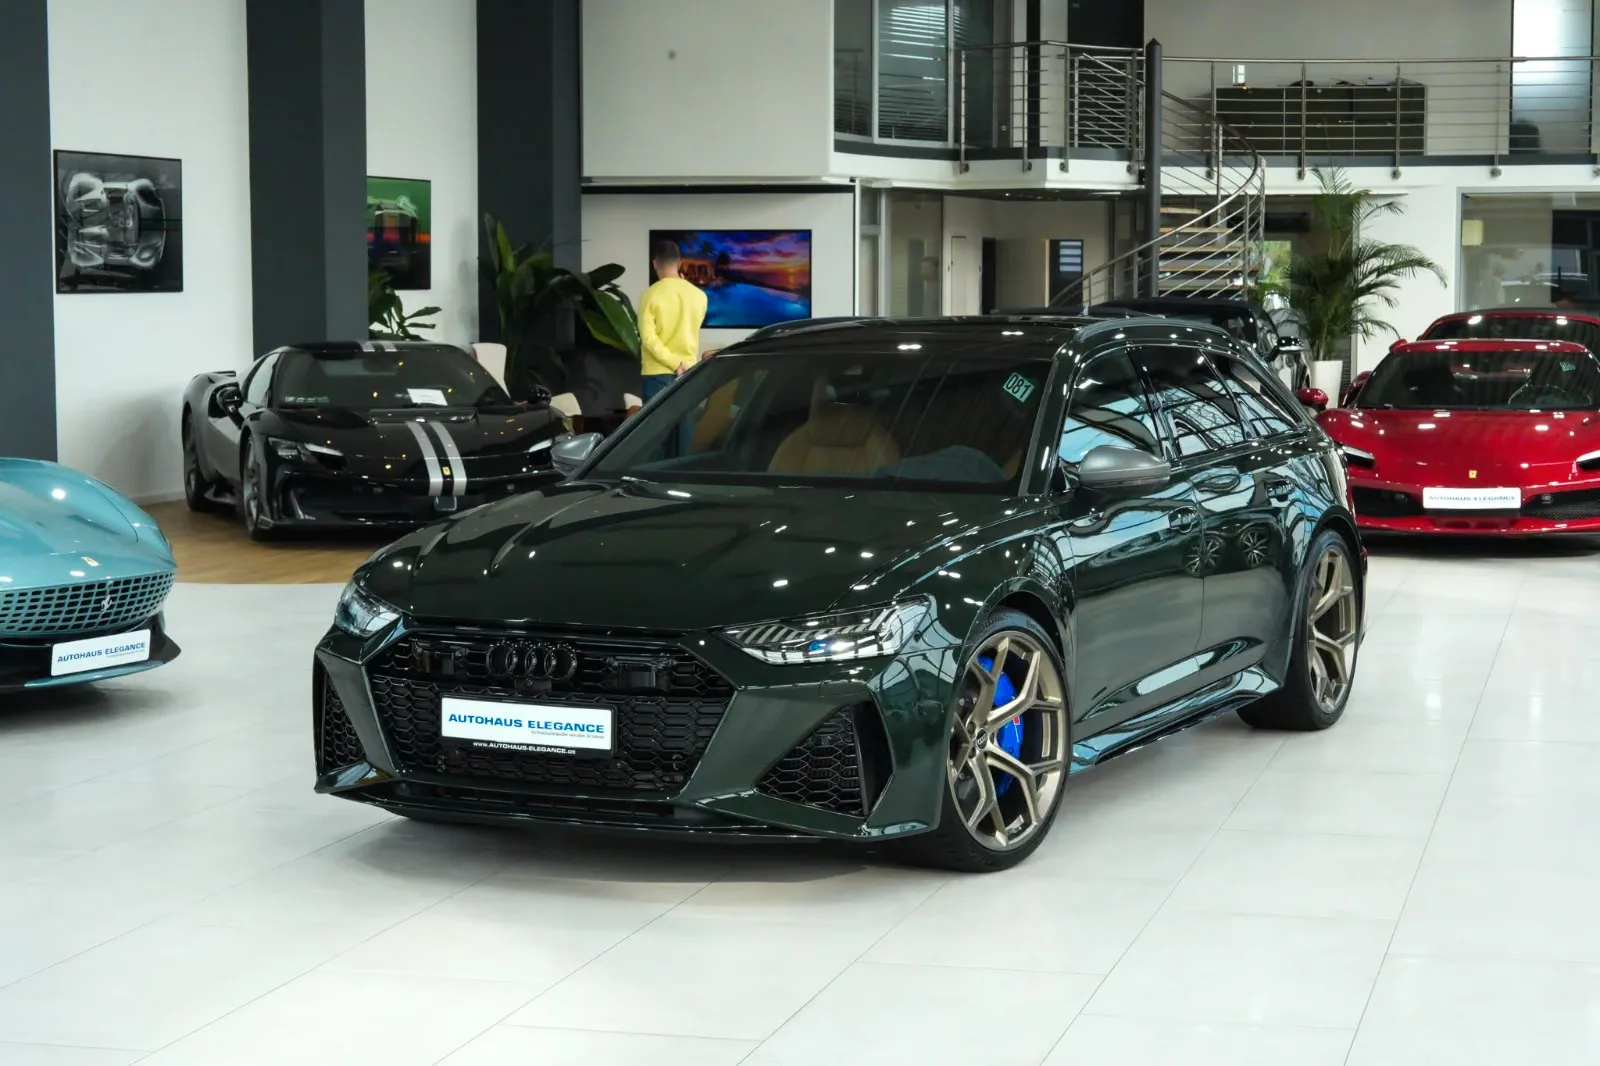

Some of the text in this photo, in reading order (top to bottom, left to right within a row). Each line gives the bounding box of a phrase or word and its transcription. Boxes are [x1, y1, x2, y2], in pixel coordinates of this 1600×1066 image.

[1006, 375, 1030, 399] 081
[57, 650, 103, 662] AUTOHAUS
[104, 642, 145, 655] ELEGANCE
[448, 713, 605, 734] AUTOHAUS ELEGANCE
